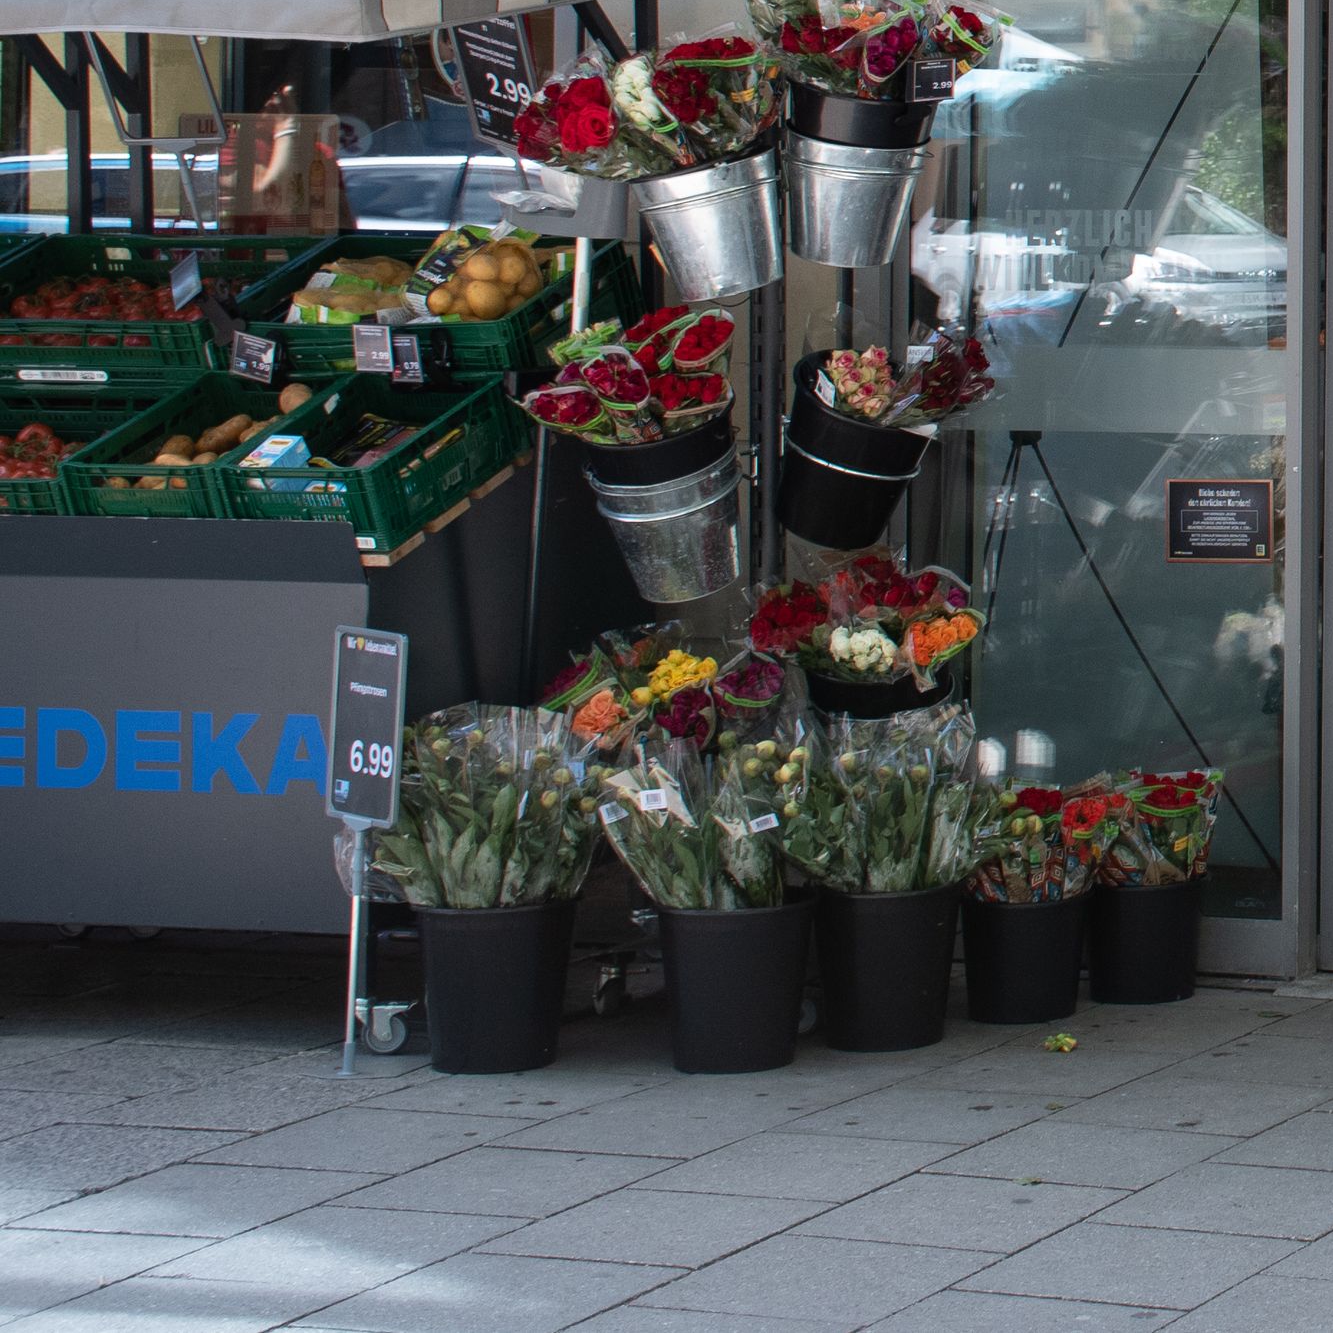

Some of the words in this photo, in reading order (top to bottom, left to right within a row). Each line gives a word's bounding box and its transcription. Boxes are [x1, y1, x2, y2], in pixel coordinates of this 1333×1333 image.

[485, 73, 532, 106] 2.99
[932, 81, 952, 89] 2.99
[350, 739, 393, 778] 6.99
